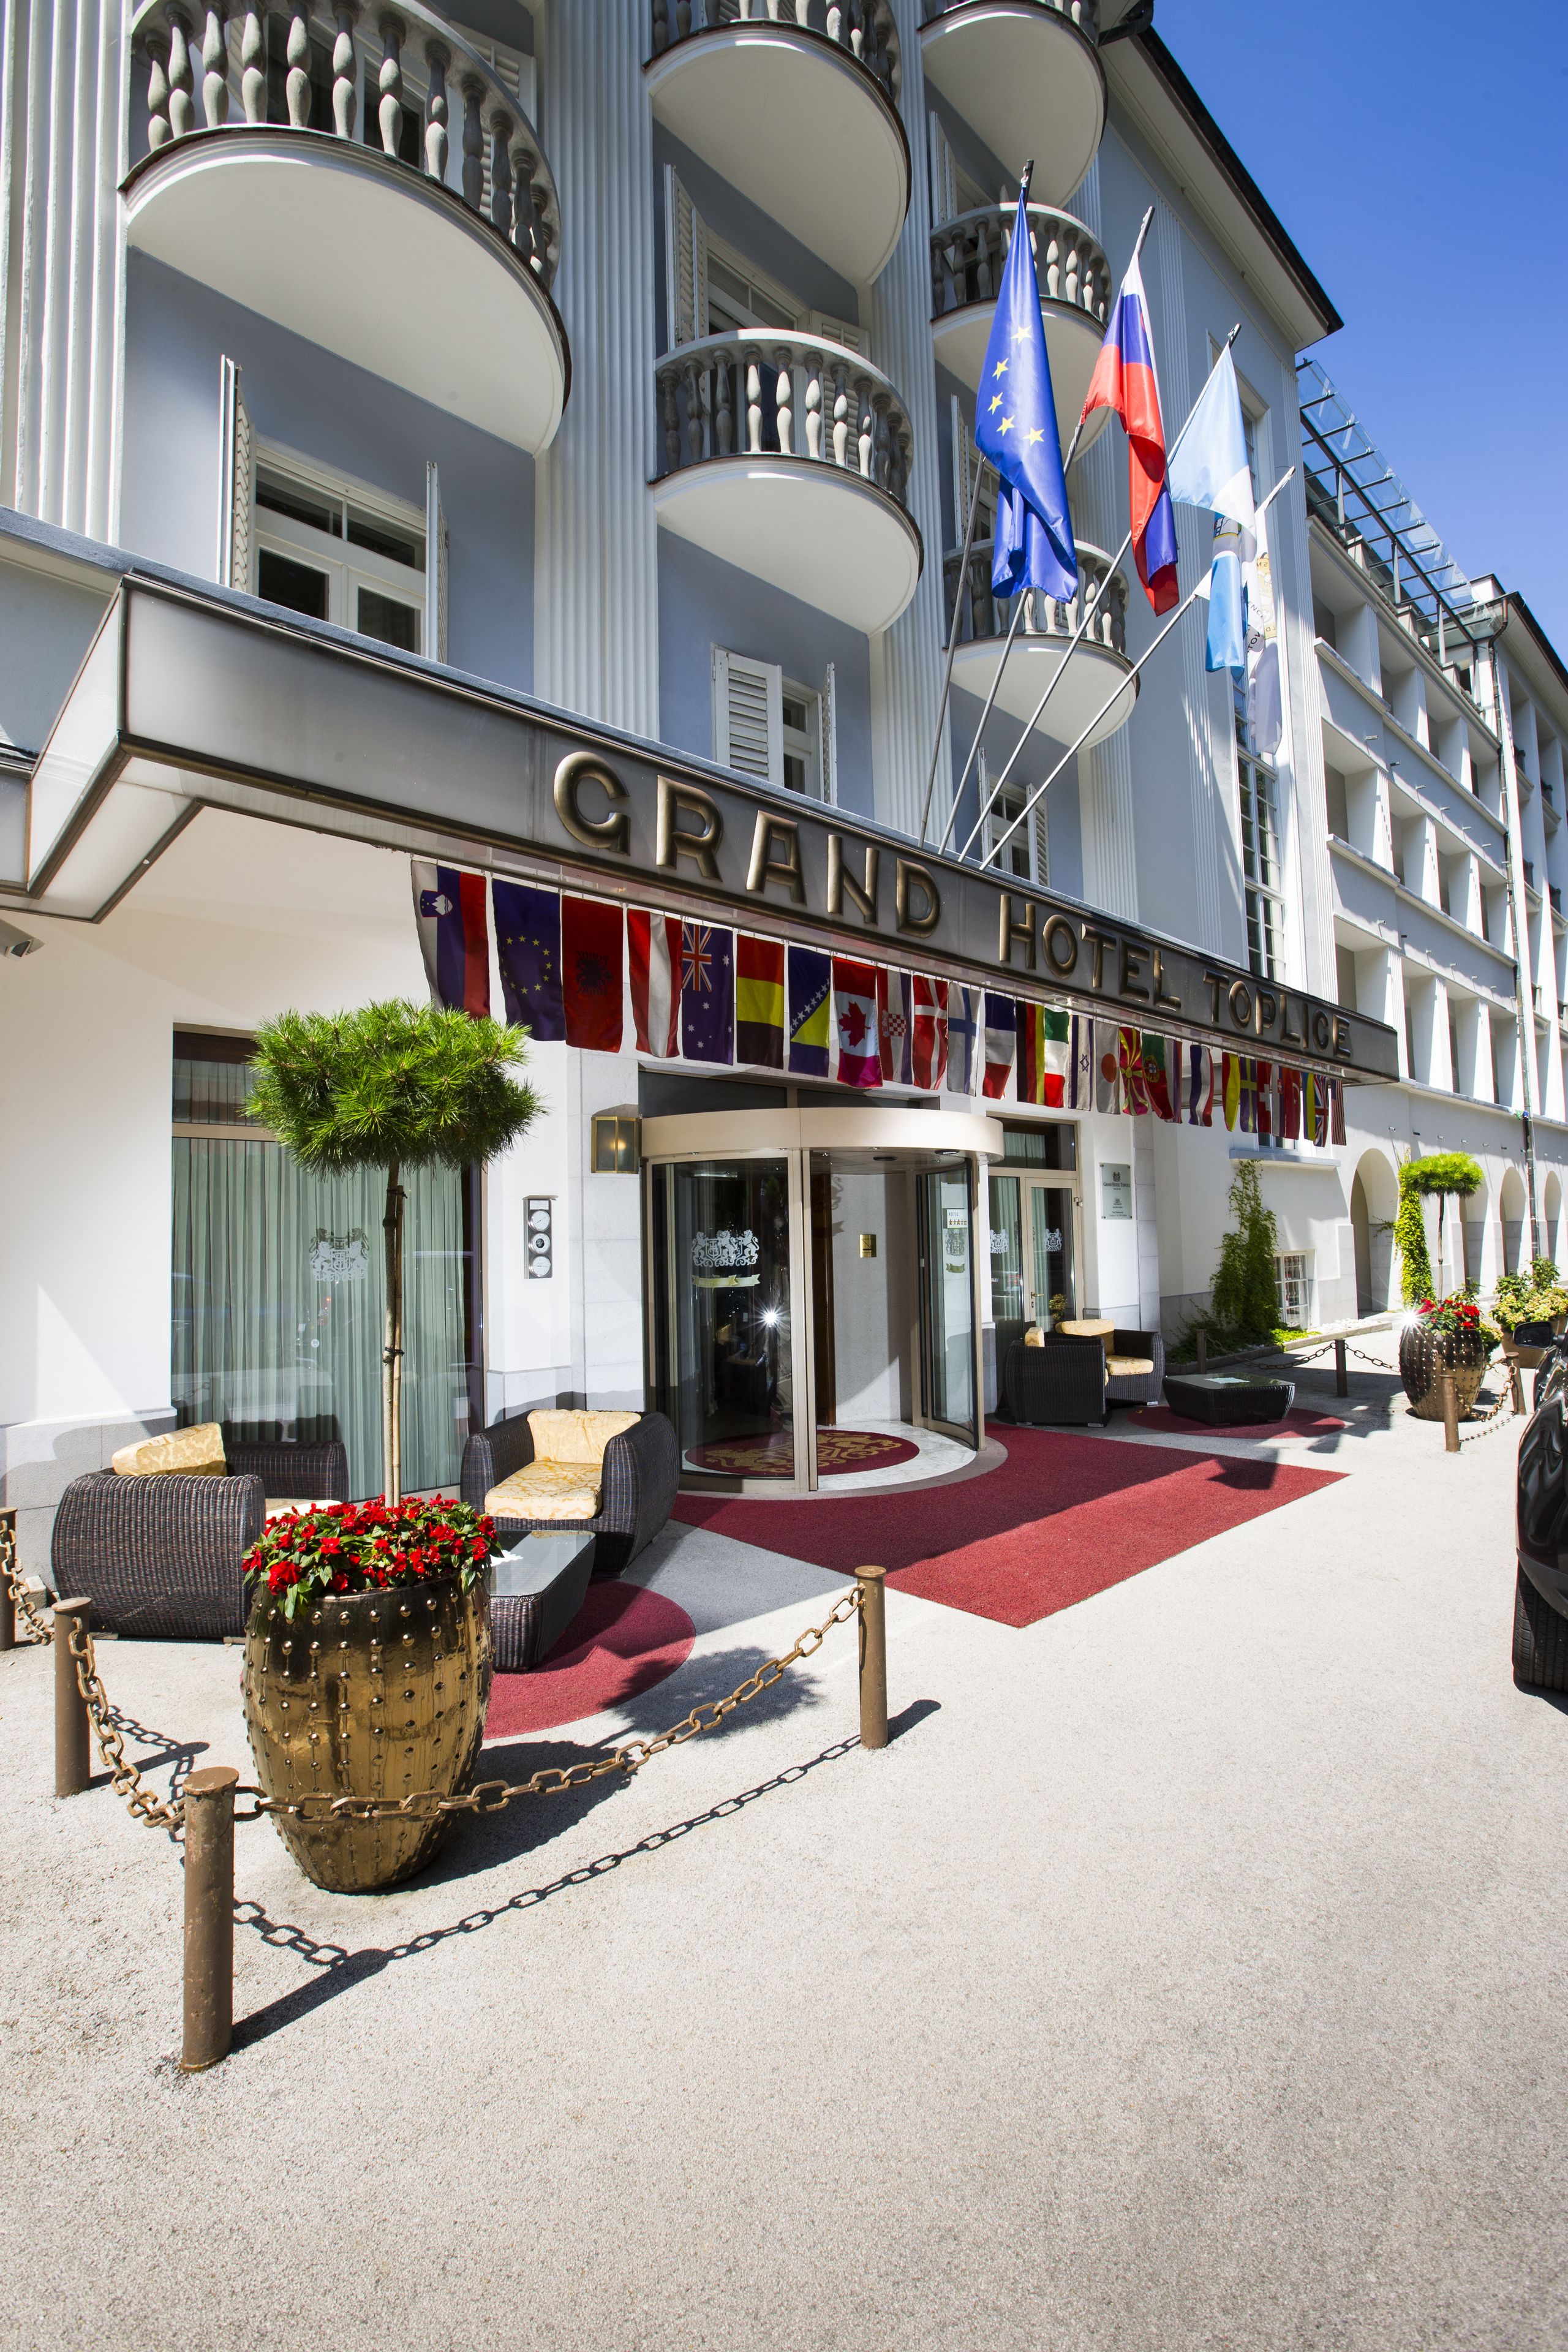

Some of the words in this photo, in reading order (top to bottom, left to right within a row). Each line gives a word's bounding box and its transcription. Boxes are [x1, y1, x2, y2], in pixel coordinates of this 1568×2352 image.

[554, 751, 941, 938] GRAND
[999, 894, 1182, 1011] HOTEL
[1203, 968, 1351, 1059] TOPLICE
